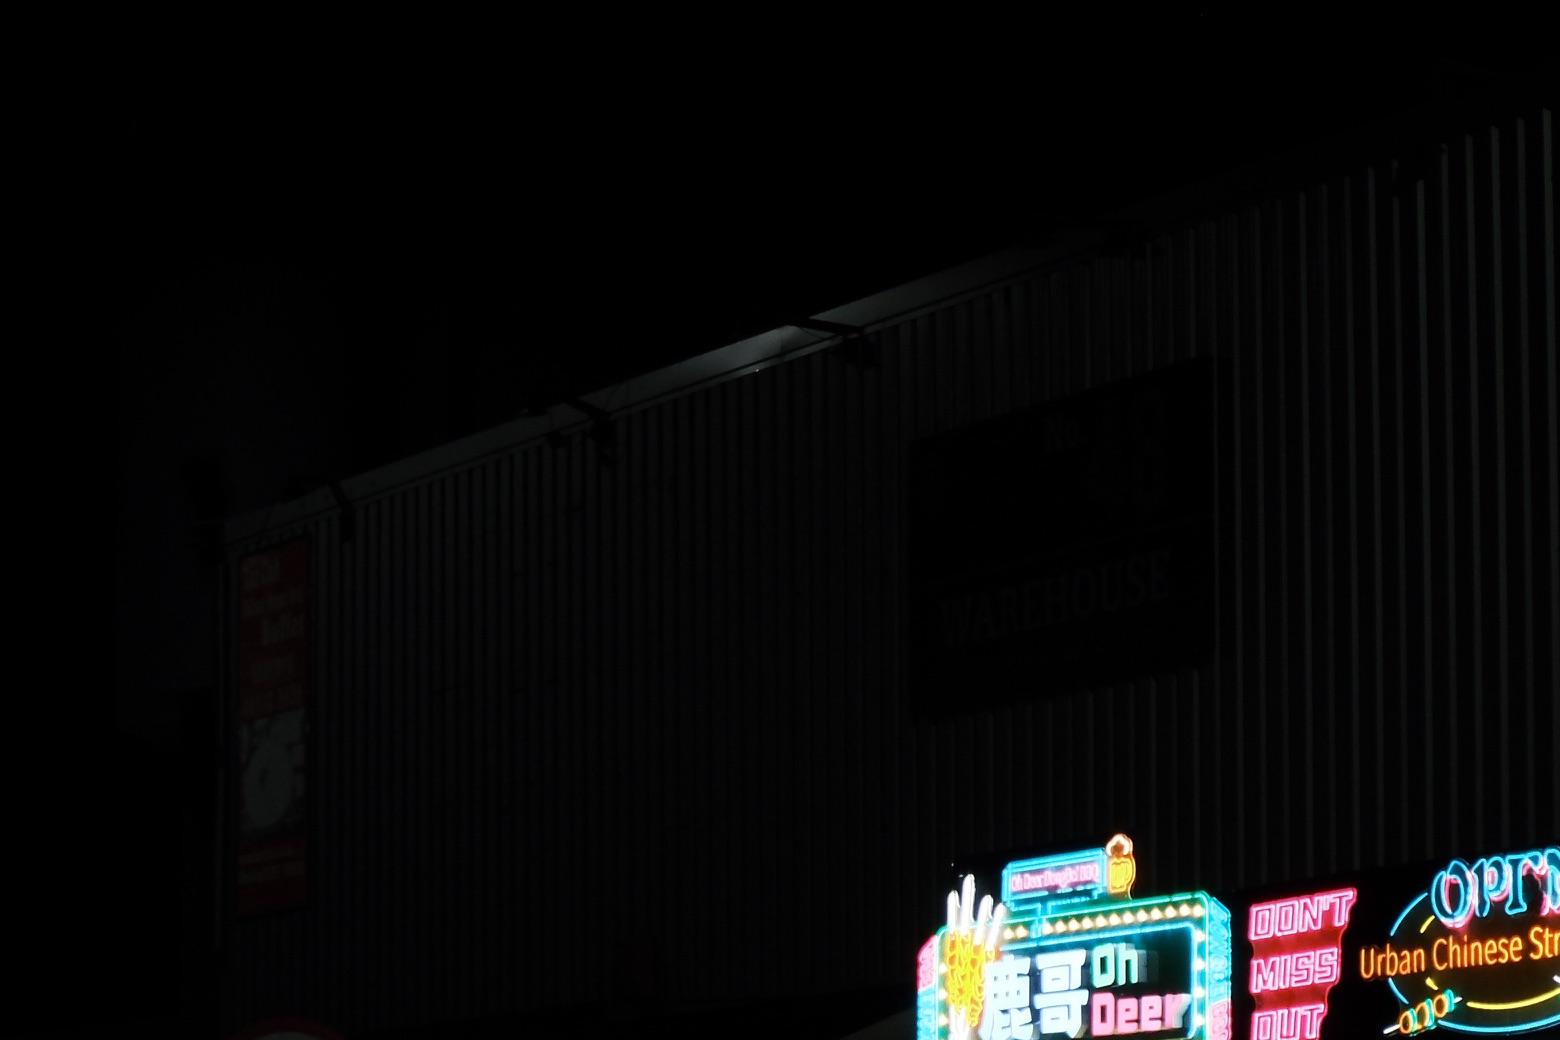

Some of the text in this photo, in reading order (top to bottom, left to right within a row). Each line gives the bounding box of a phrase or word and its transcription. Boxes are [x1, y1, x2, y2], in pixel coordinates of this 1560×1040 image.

[937, 547, 1171, 648] WAREHOUSE
[1249, 888, 1357, 941] DON'T
[1091, 943, 1140, 989] Oh
[1251, 947, 1342, 993] MISS
[1360, 944, 1426, 981] Urban
[1432, 933, 1522, 973] Chinese
[1091, 991, 1190, 1037] Deer
